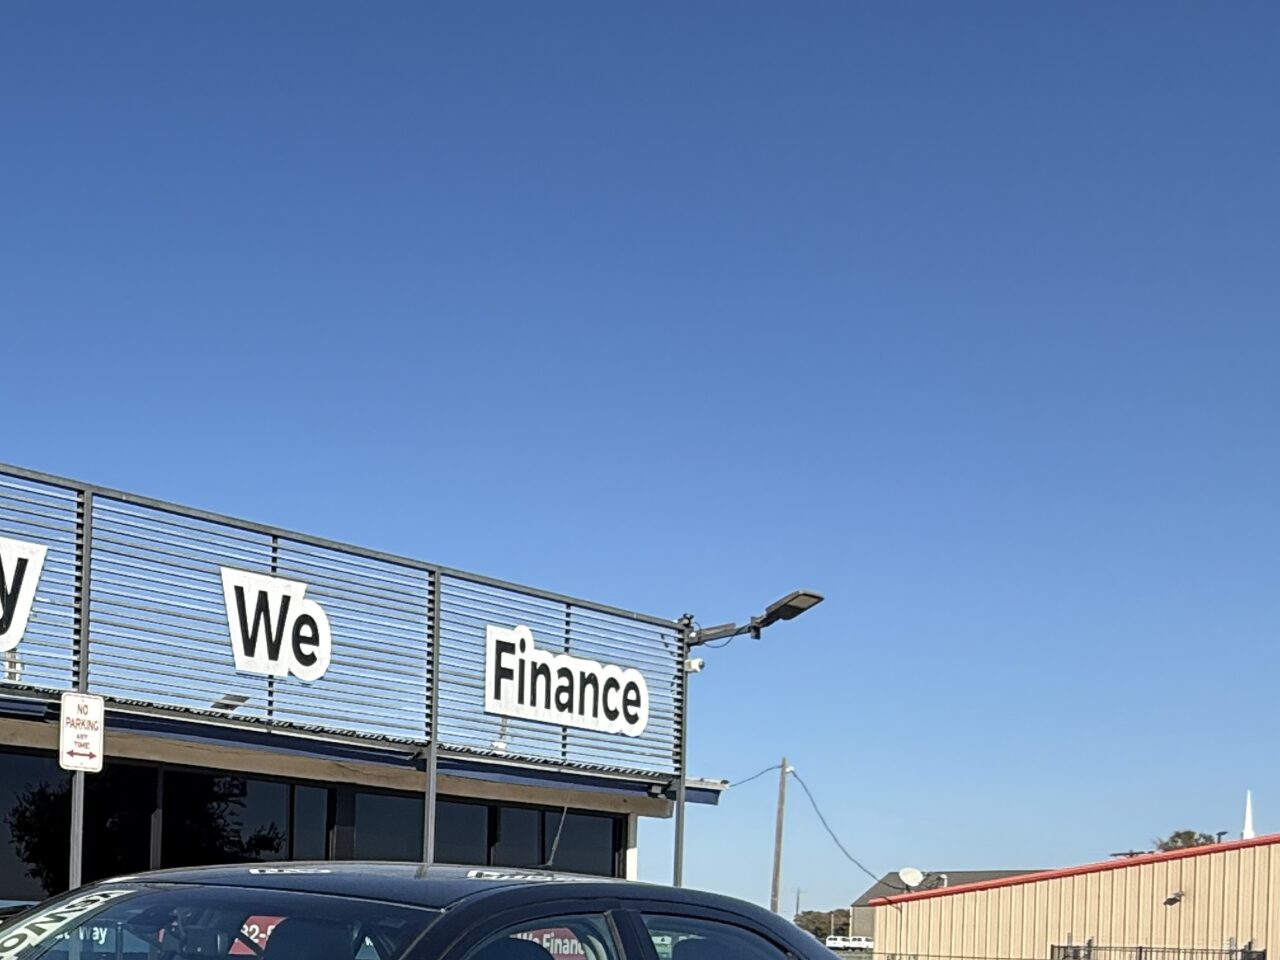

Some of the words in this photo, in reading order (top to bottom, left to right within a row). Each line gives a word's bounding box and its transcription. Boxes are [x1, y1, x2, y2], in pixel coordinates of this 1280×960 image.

[234, 585, 320, 666] We
[494, 638, 641, 725] Finance
[77, 703, 89, 715] NO
[65, 717, 99, 731] PARKING
[73, 741, 90, 749] TIME
